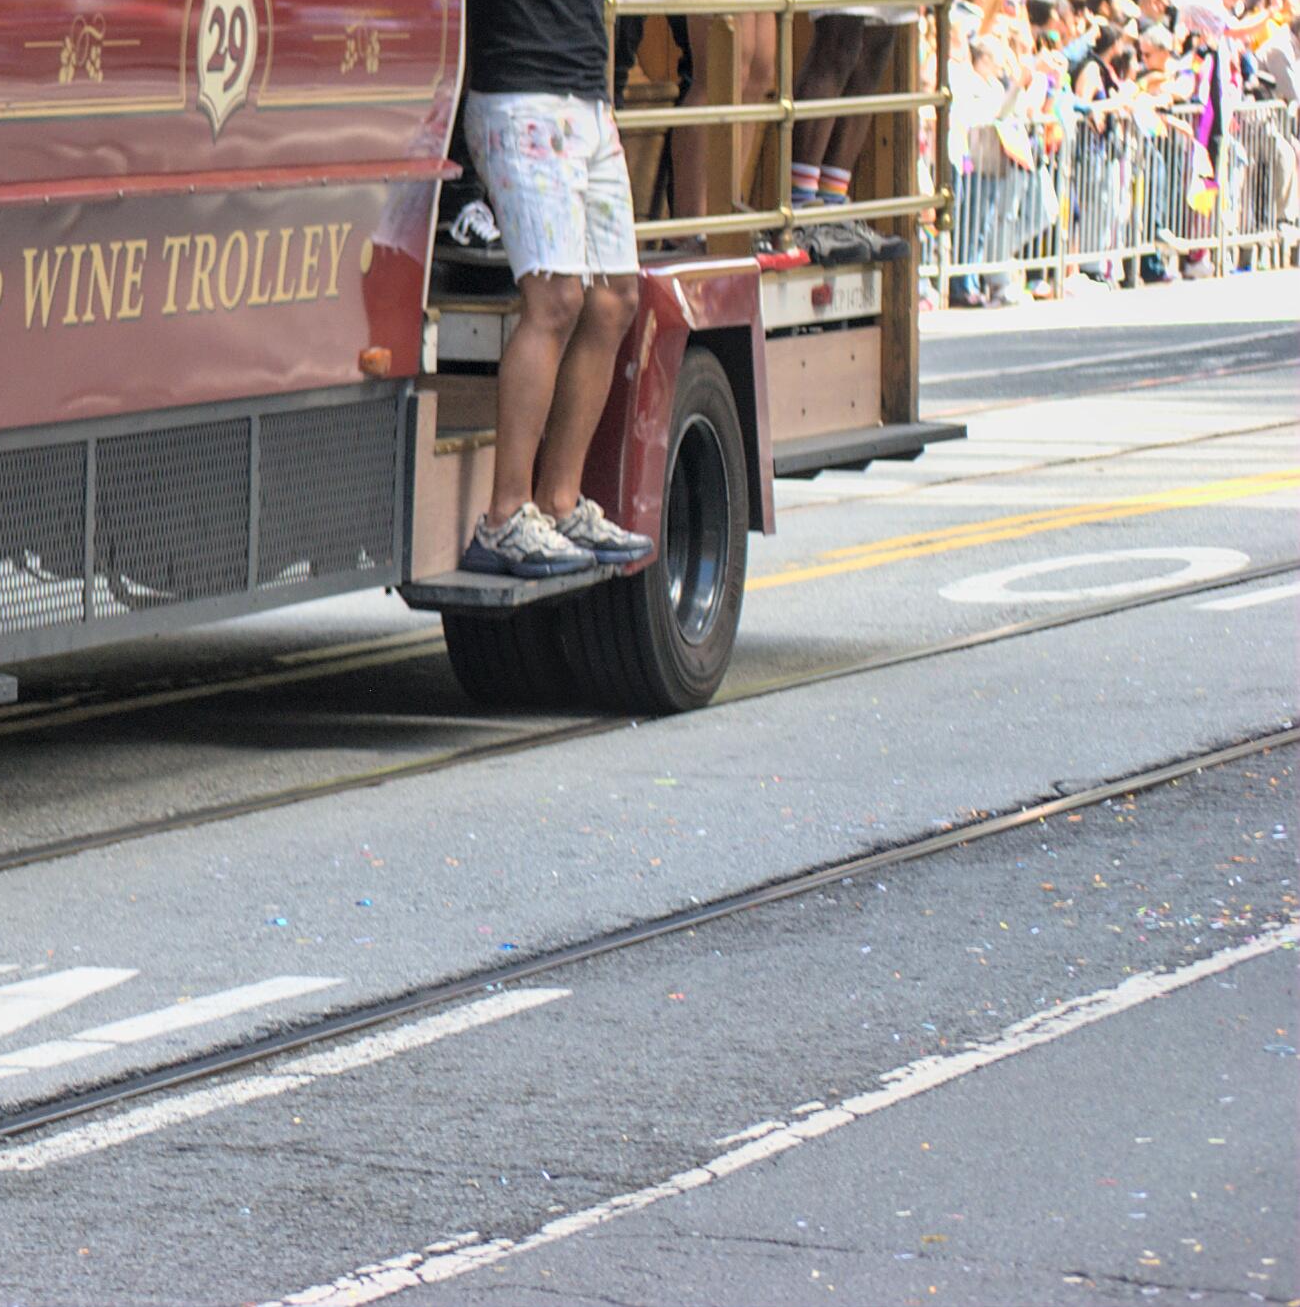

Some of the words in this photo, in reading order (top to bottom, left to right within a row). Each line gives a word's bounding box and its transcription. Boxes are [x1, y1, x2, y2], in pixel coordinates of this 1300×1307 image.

[207, 5, 248, 93] 29
[22, 239, 149, 330] WINE
[161, 222, 353, 315] TROLLEY
